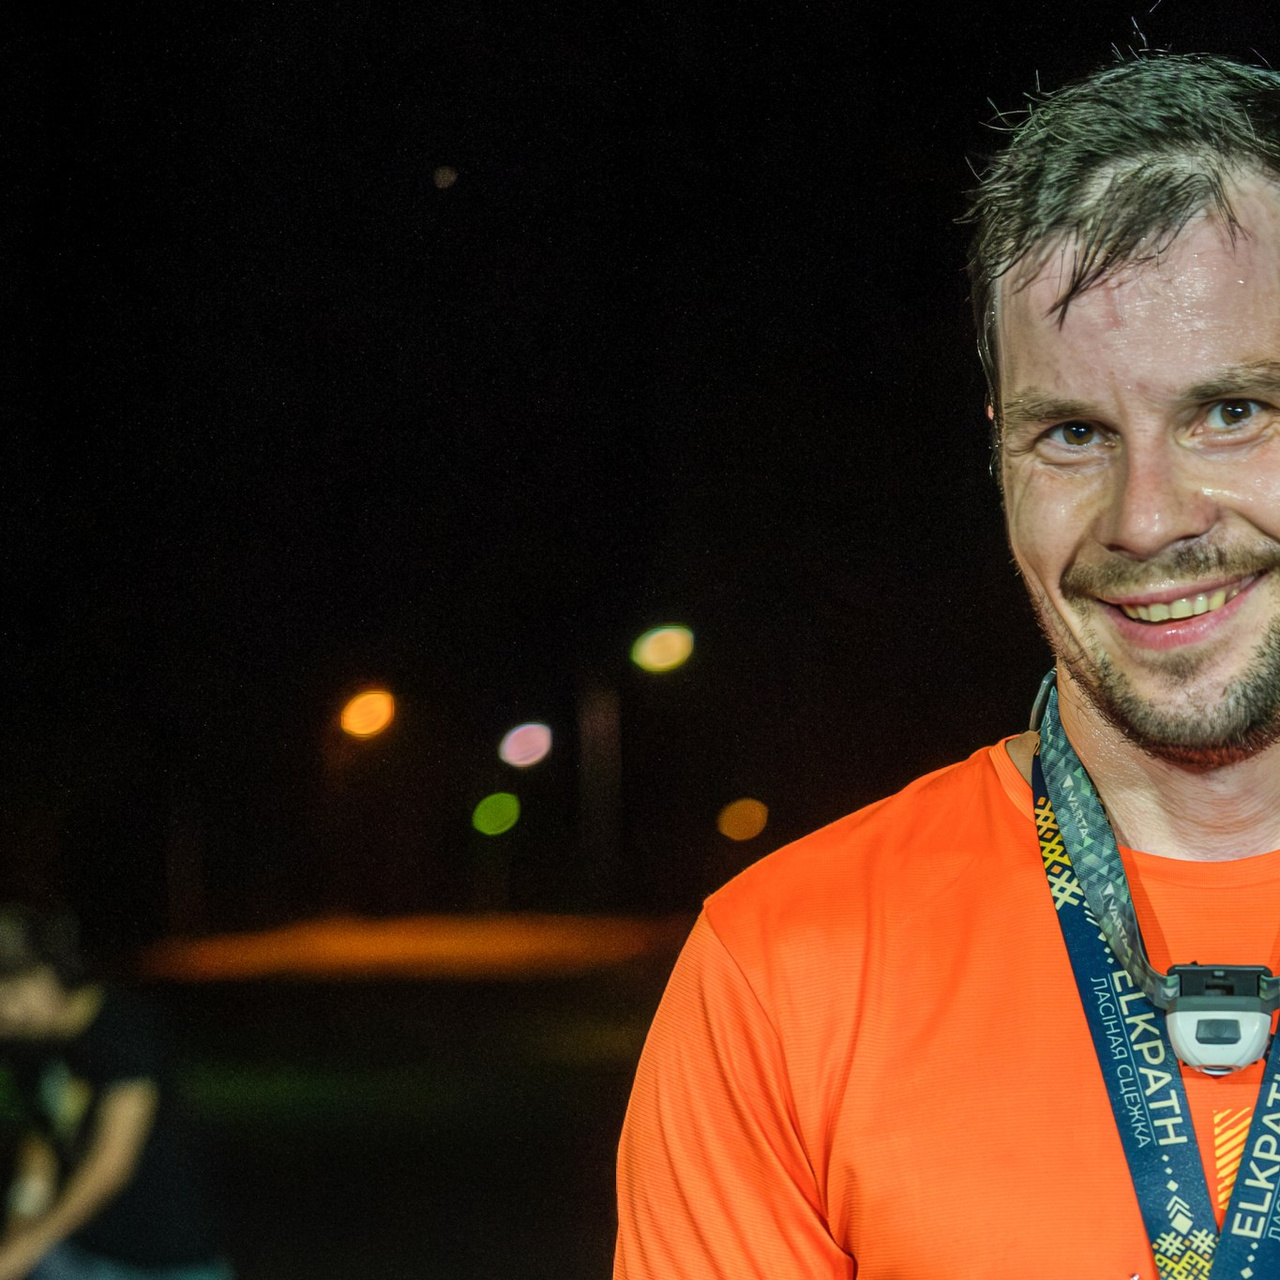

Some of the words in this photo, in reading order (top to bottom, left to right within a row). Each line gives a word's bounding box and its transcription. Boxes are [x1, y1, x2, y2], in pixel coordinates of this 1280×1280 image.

[1067, 790, 1089, 839] VARTA
[1108, 898, 1129, 950] VARTA
[1090, 977, 1128, 1060] ЛАСІНАЯ
[1117, 1064, 1151, 1148] СЦЕЖКА
[1112, 970, 1188, 1146] ELKPATH
